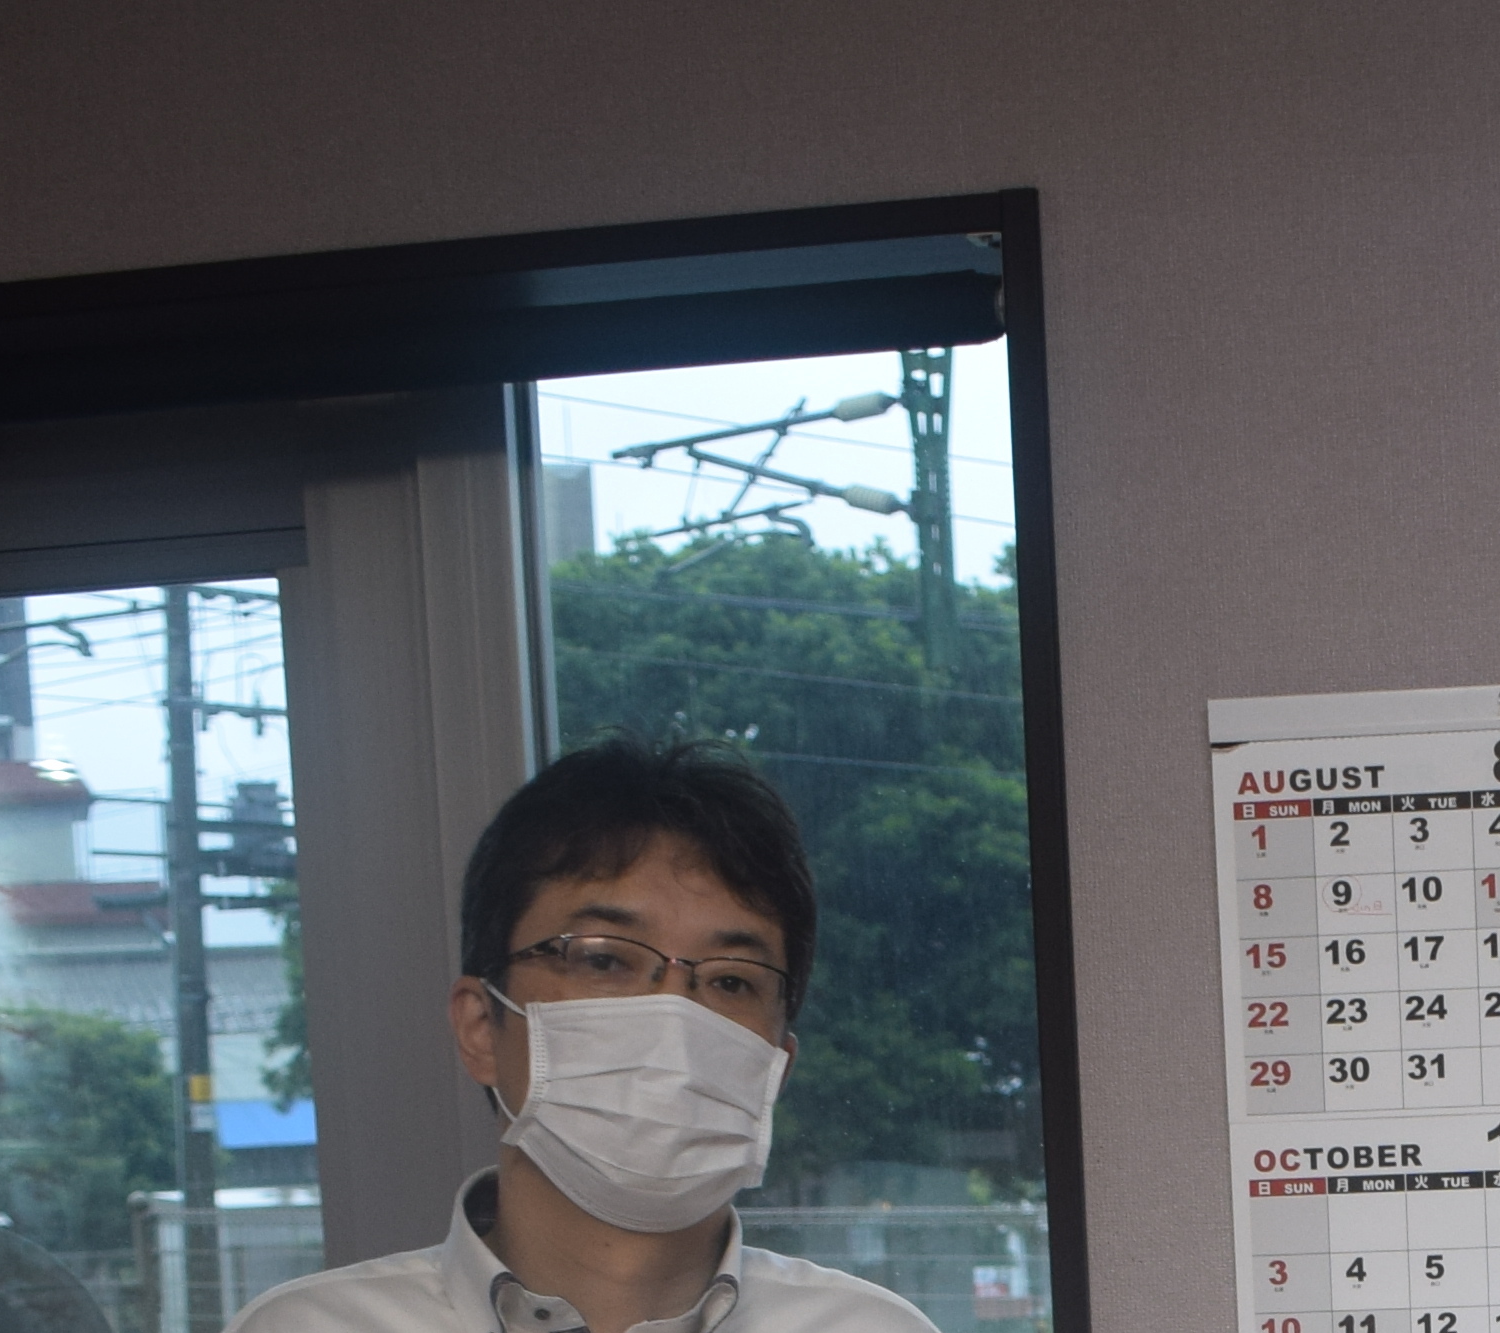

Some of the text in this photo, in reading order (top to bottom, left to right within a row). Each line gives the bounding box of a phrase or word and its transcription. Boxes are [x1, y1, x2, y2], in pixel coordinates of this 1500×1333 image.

[1238, 766, 1385, 795] AUGUST
[1243, 804, 1255, 818] 日
[1269, 804, 1298, 817] SUN
[1322, 800, 1335, 815] 月
[1349, 801, 1381, 812] MON
[1402, 797, 1415, 810] 火
[1428, 797, 1457, 808] TUE
[1481, 792, 1495, 806] 水
[1252, 825, 1266, 850] 1
[1330, 822, 1349, 846] 2
[1410, 818, 1429, 842] 3
[1254, 884, 1272, 909] 8
[1333, 881, 1351, 905] 9
[1402, 877, 1442, 902] 10
[1246, 943, 1286, 968] 15
[1325, 940, 1365, 964] 16
[1404, 936, 1444, 961] 17
[1248, 1002, 1288, 1027] 22
[1327, 999, 1367, 1024] 23
[1406, 995, 1447, 1020] 24
[1250, 1054, 1444, 1086] 29 30 31
[1254, 1144, 1422, 1173] OCTOBER
